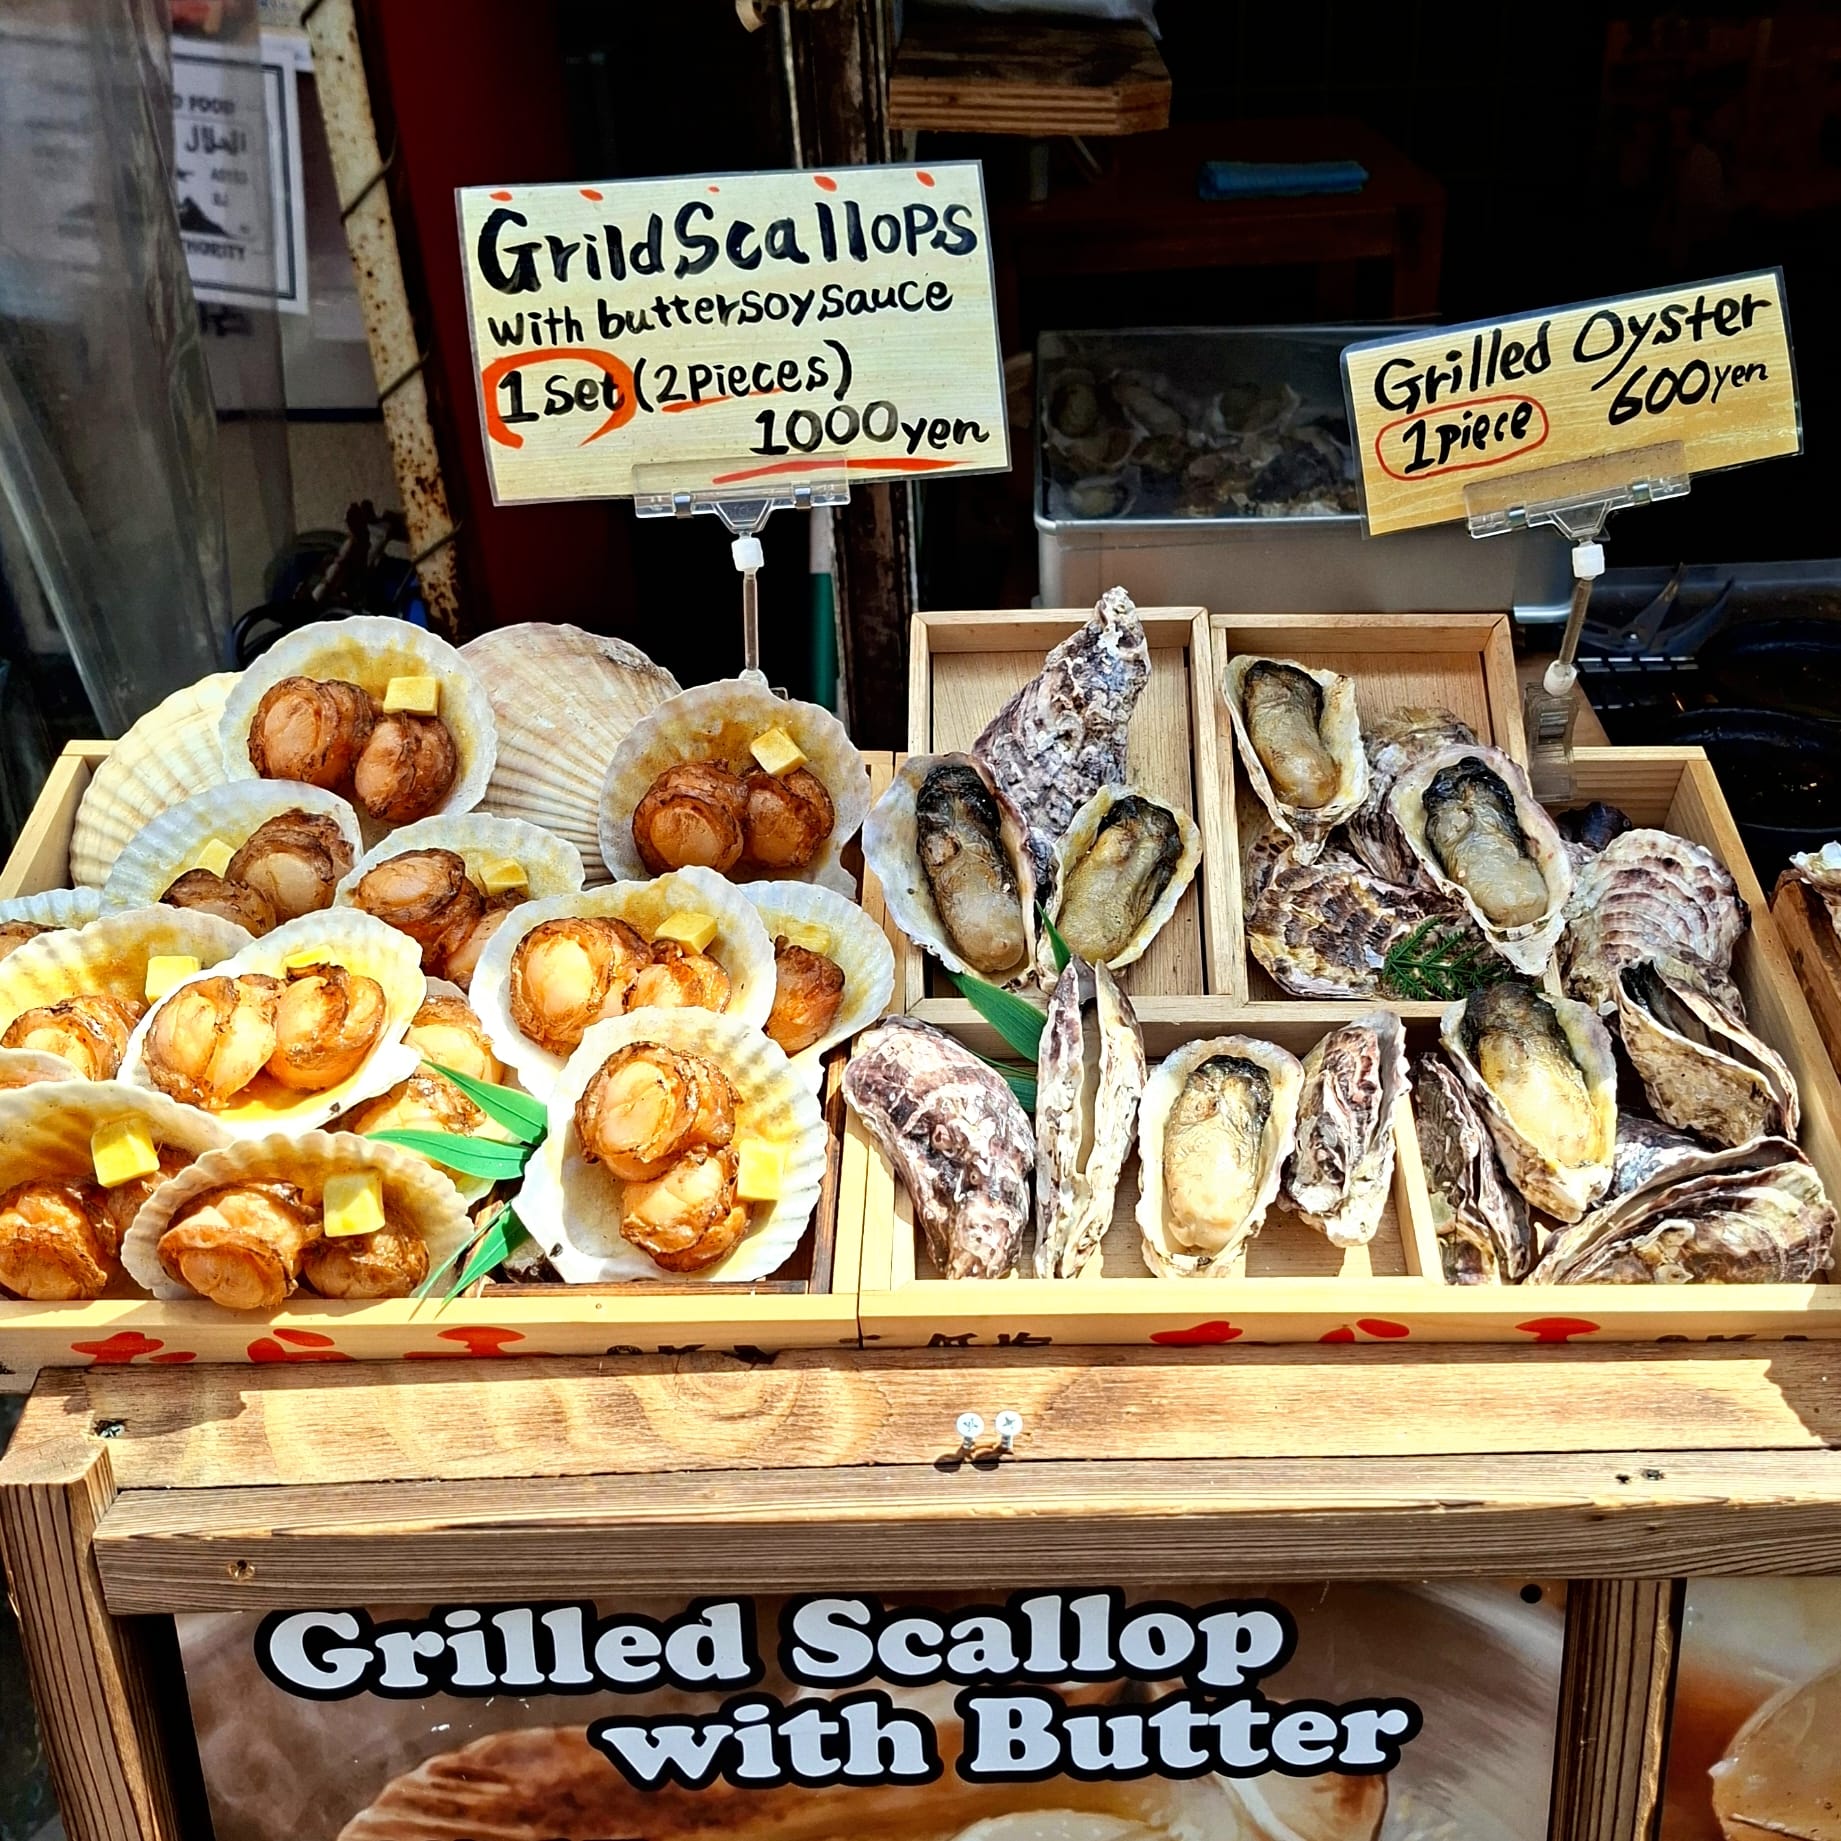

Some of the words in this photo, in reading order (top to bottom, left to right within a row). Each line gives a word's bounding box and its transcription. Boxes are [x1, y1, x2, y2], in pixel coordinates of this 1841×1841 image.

[1373, 320, 1552, 415] Grilled
[1572, 292, 1773, 392] Oyster
[266, 1602, 754, 1693] Grilled
[789, 1594, 1287, 1689] Scallop
[598, 1701, 934, 1784] with
[966, 1693, 1411, 1777] Butter
